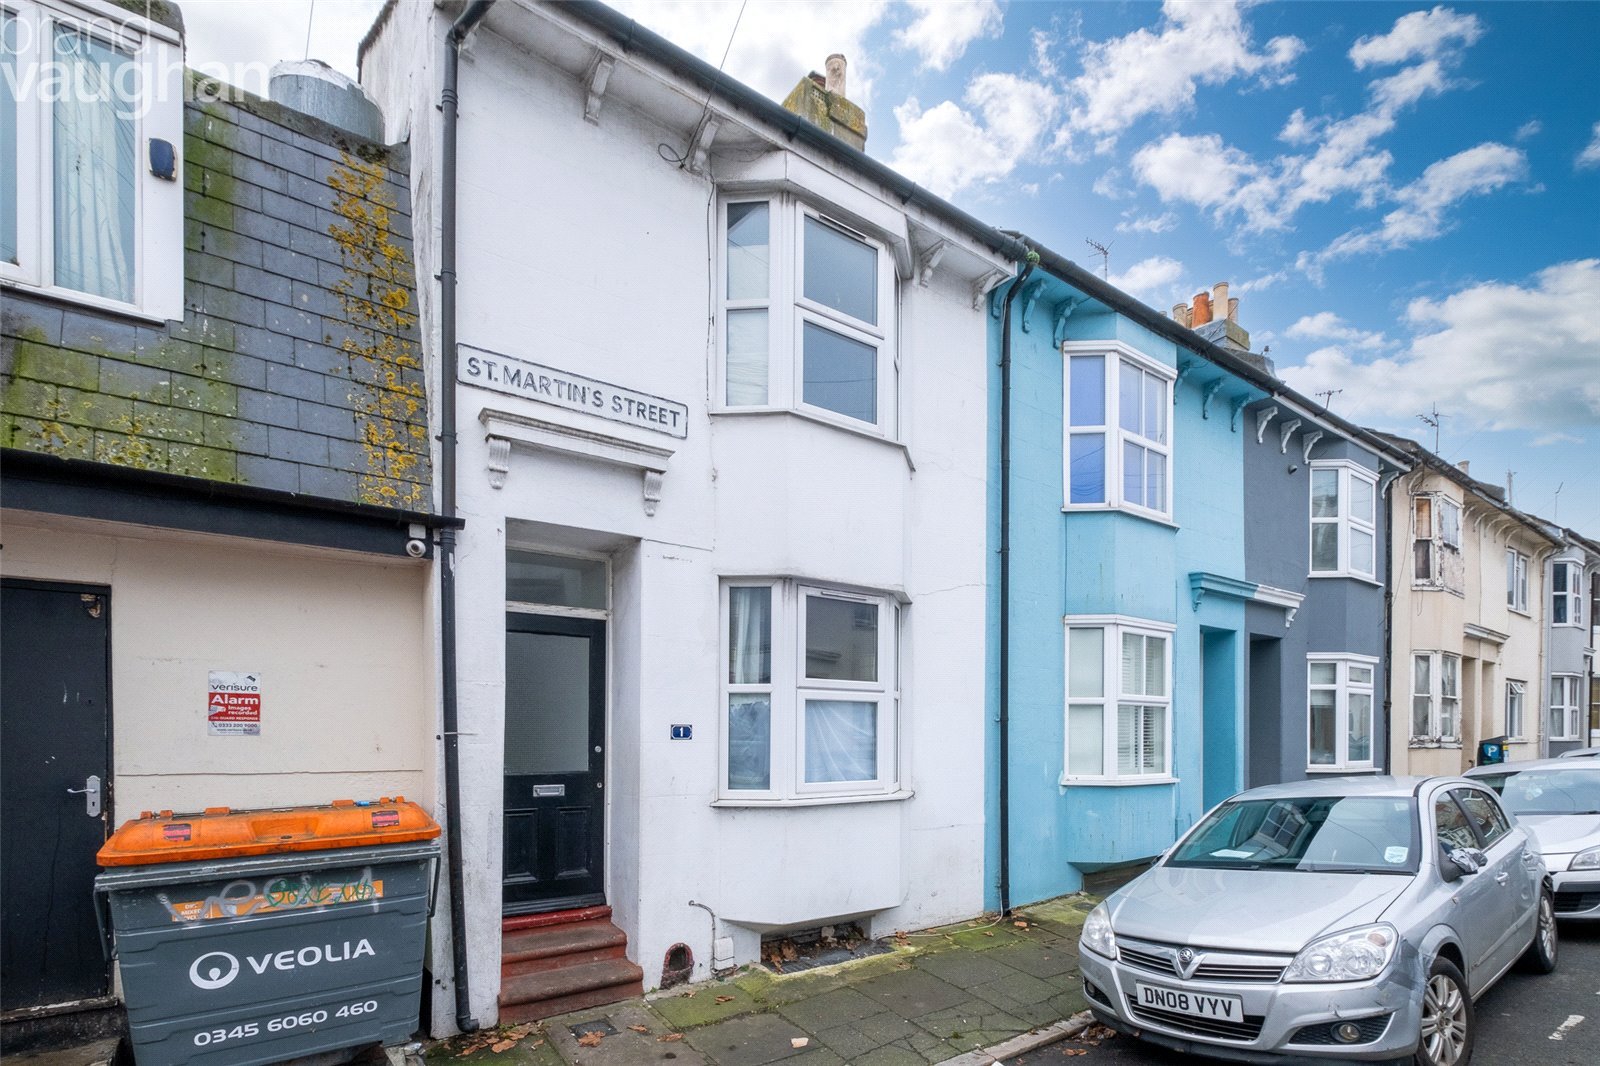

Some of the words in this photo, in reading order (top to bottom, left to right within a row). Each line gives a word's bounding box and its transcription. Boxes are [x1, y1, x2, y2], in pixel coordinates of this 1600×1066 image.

[611, 394, 681, 428] STREET
[211, 684, 258, 692] verisure
[211, 694, 259, 705] Alarm
[246, 938, 376, 975] VEOLIA
[1143, 987, 1190, 1011] DN08
[1194, 995, 1233, 1018] VYV
[193, 1023, 260, 1046] 0345
[266, 1010, 328, 1033] 6060
[334, 1000, 379, 1019] 460
